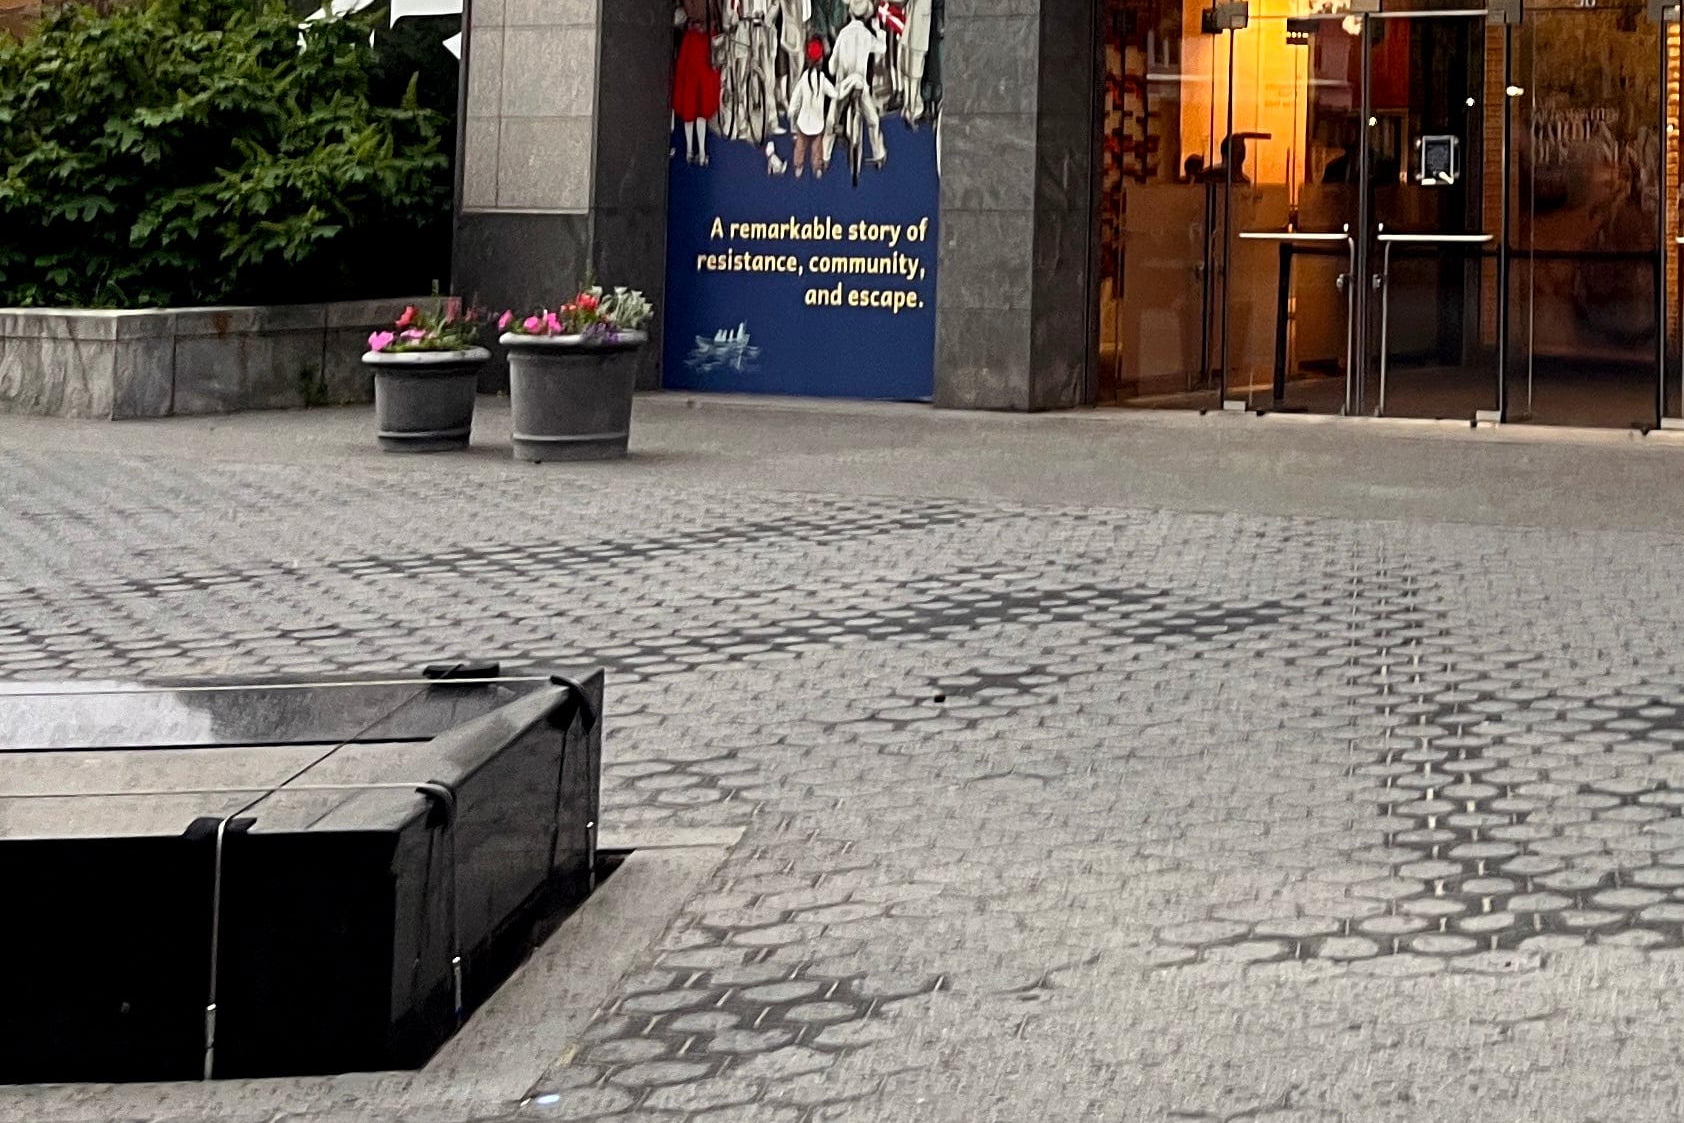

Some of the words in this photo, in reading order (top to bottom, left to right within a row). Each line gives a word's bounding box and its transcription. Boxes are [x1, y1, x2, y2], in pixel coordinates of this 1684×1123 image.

[710, 216, 724, 240] A
[730, 215, 843, 240] remarkable
[848, 219, 901, 248] story
[906, 216, 929, 242] of
[696, 247, 804, 276] resistance,
[808, 250, 926, 281] community,
[804, 281, 843, 307] and
[847, 289, 924, 314] escape.
